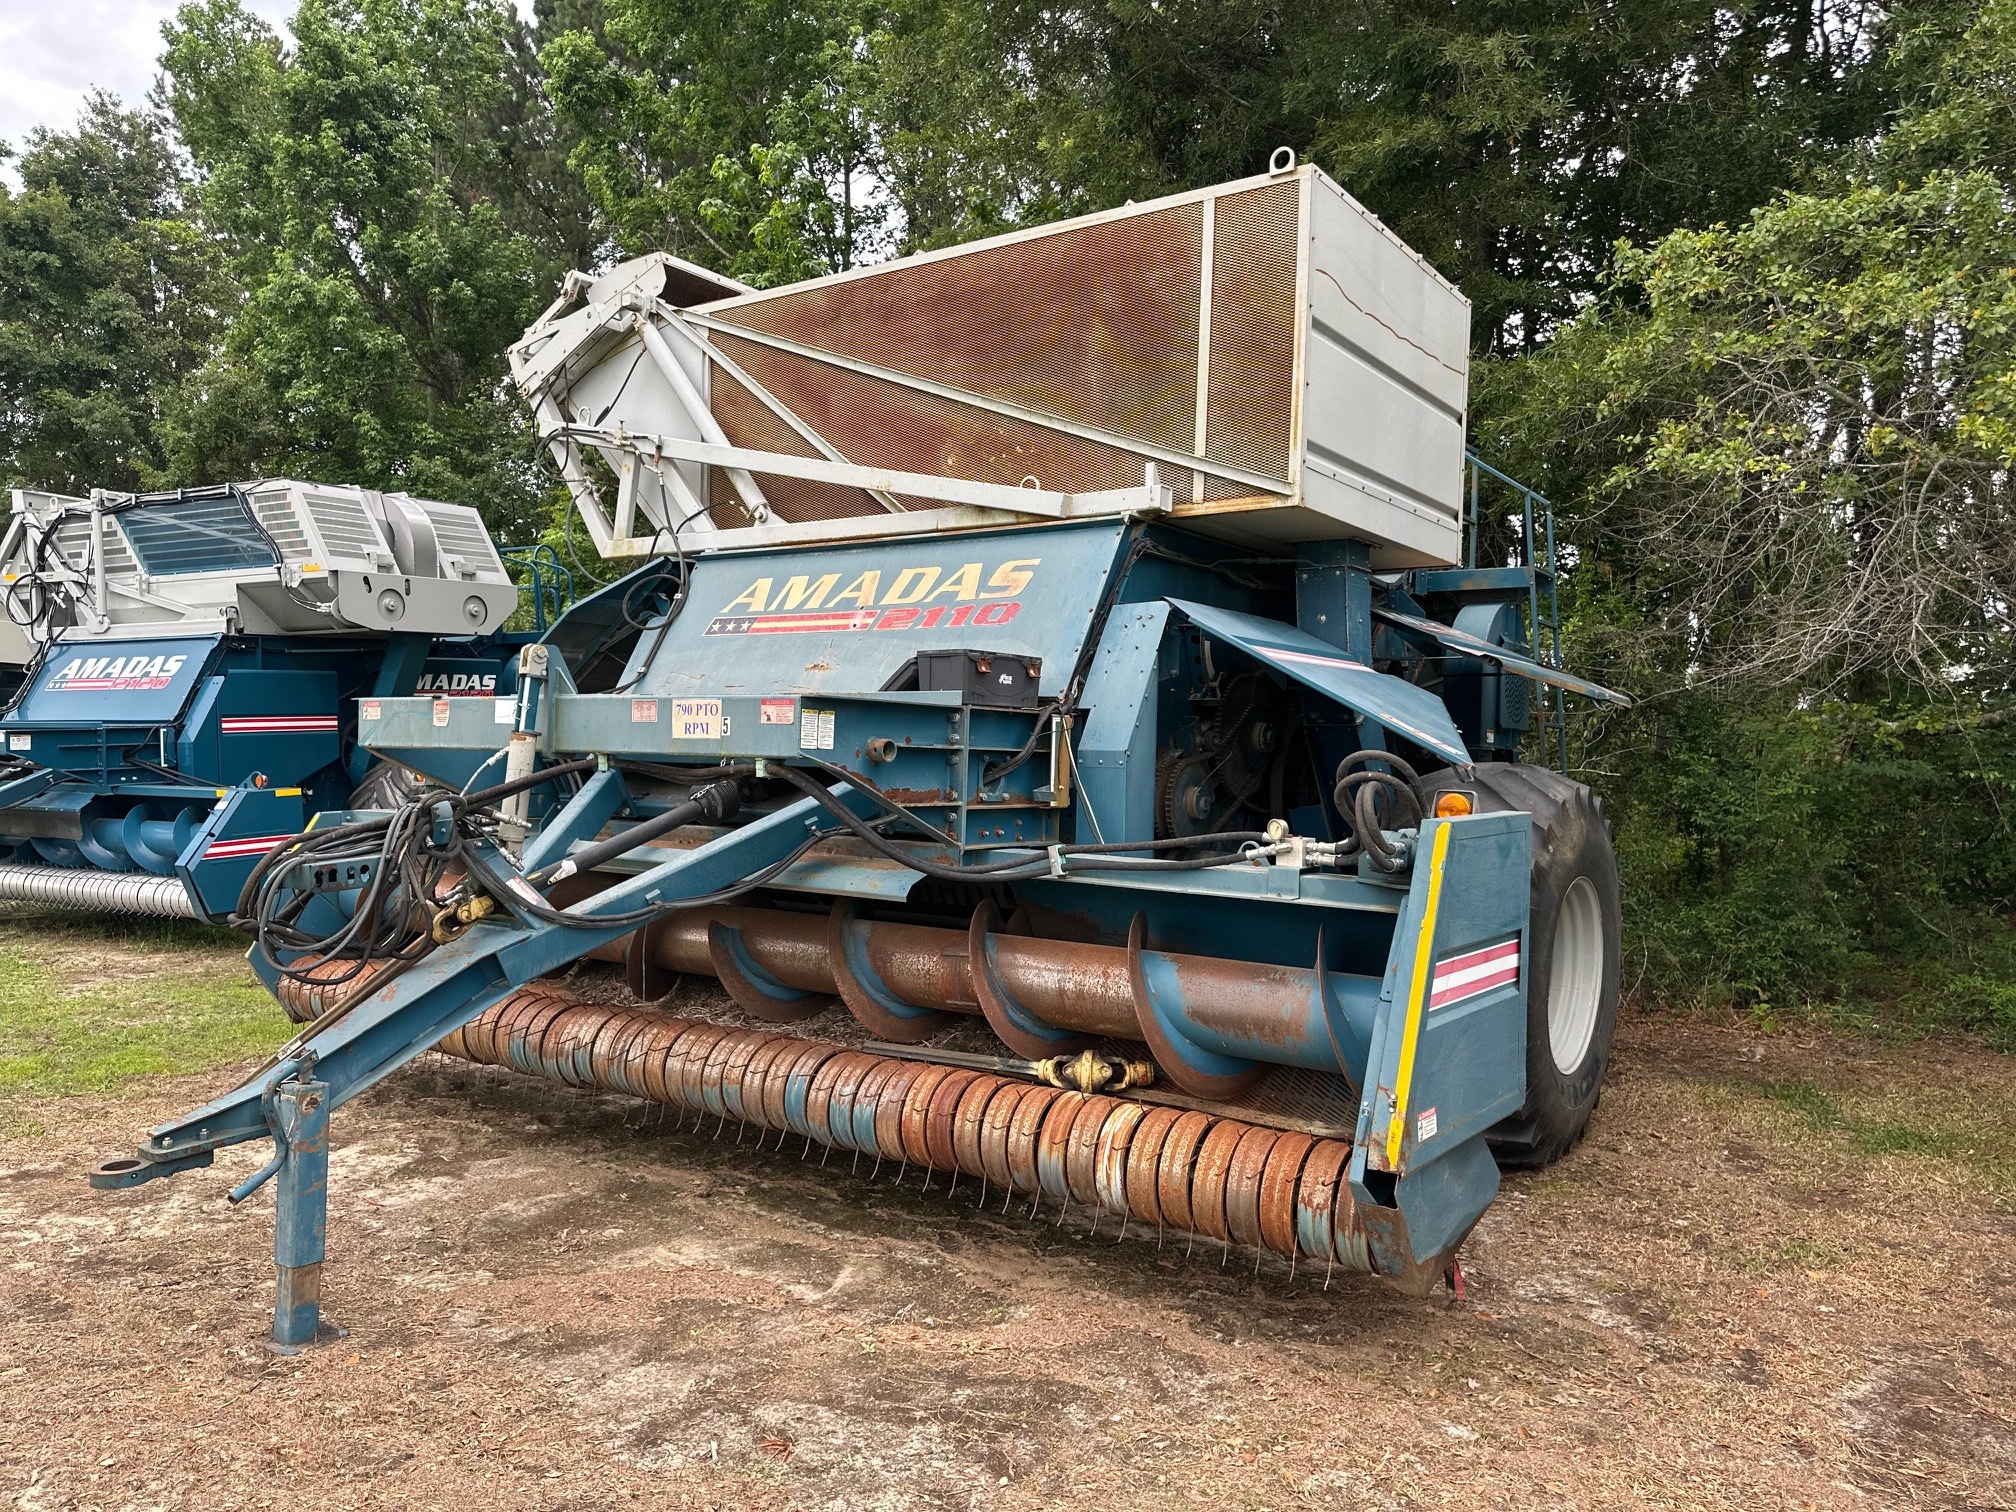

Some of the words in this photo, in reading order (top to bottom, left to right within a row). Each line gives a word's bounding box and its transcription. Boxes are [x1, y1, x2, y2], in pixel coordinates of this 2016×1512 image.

[721, 559, 1041, 613] AMADAS
[873, 601, 1023, 631] 2110
[54, 654, 189, 680] AMADAS
[110, 676, 172, 691] 2120
[417, 674, 497, 690] MADAS
[676, 703, 693, 716] 790
[696, 703, 719, 716] PTO
[684, 722, 709, 735] RPM
[723, 718, 729, 735] 5
